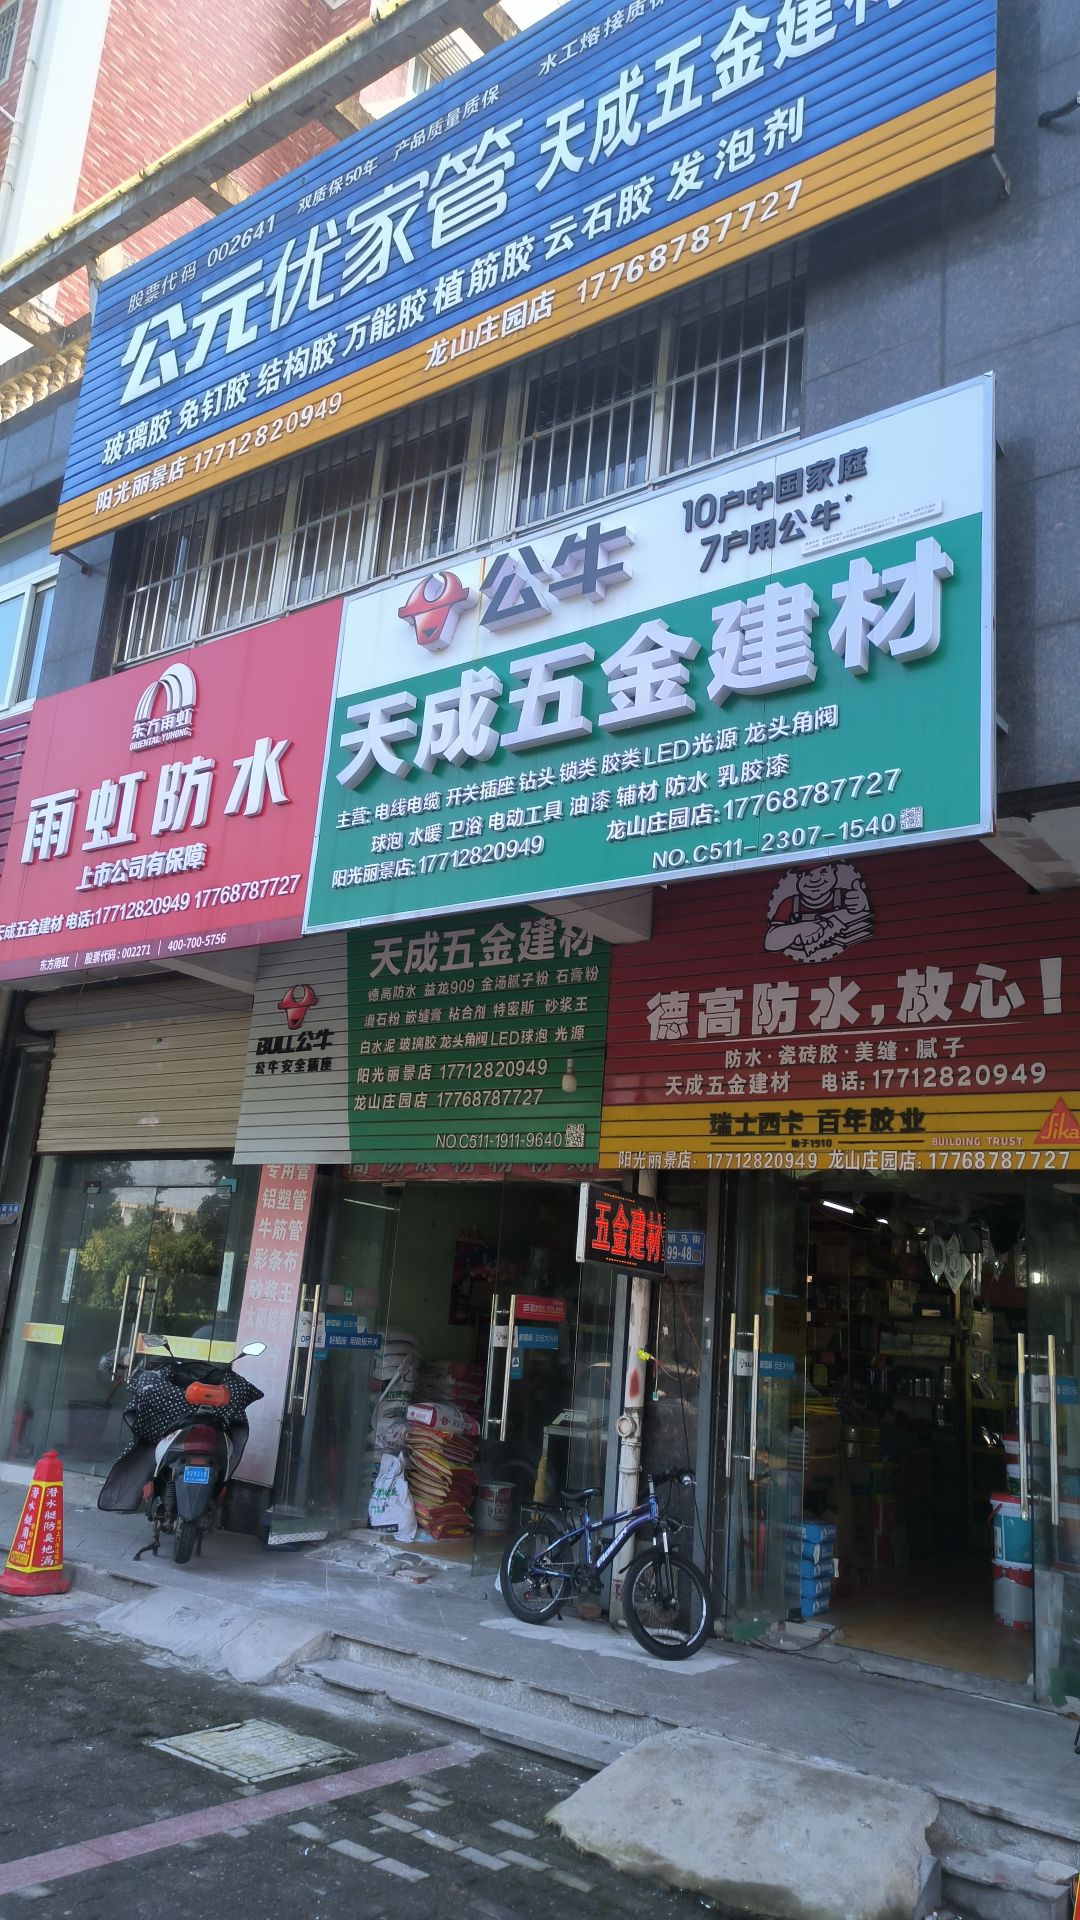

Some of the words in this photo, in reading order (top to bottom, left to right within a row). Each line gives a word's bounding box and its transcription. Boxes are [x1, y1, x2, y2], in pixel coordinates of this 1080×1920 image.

[127, 260, 197, 314] 股票代码
[207, 213, 276, 268] 002641
[297, 156, 378, 214] 双质保50年
[393, 85, 500, 162] 产品质量质保
[119, 117, 524, 406] 公元优家管
[101, 409, 174, 466] 玻璃胶
[175, 372, 251, 435] 免钉胶
[255, 330, 338, 398] 结构胶
[340, 288, 428, 357] 万能胶
[432, 236, 534, 315] 植筋胶
[541, 175, 655, 261] 云石胶
[665, 97, 804, 202] 发泡剂
[94, 455, 186, 515] 阳光丽景店
[191, 391, 343, 474] 17712820949
[424, 288, 556, 372] 龙山庄园店
[575, 179, 803, 304] 17768787727
[682, 446, 868, 533] 10户中国家庭
[478, 520, 636, 634] 公牛
[334, 534, 956, 791] 天成五金建材
[129, 735, 162, 751] ORIENTAL
[162, 726, 193, 742] YUHONG
[132, 708, 195, 740] 东方雨虹
[374, 791, 442, 822] 电线电缆
[445, 774, 516, 808] 开关插座
[518, 766, 556, 793] 钻头
[559, 757, 599, 784] 锁类
[743, 703, 840, 746] 龙头角阀
[20, 736, 294, 865] 雨虹防水
[370, 831, 405, 854] 球泡
[408, 823, 444, 848] 水暖
[447, 816, 484, 841] 卫浴
[488, 800, 564, 831] 电动工具
[569, 788, 611, 818] 油漆
[616, 778, 659, 808] 辅材
[665, 771, 710, 797] 防水
[718, 753, 791, 788] 乳胶漆
[75, 842, 208, 892] 上市公司有保障
[194, 873, 302, 910] 17768787727
[40, 956, 70, 971] 东方雨虹
[167, 932, 227, 952] 400-700-5756
[369, 917, 598, 978] 天成五金建材
[367, 984, 417, 1003] 德高防水
[423, 979, 475, 998] 益龙909
[480, 970, 549, 992] 金汤腻子粉
[555, 965, 600, 984] 石膏粉
[364, 1011, 401, 1029] 滑石粉
[405, 1007, 442, 1025] 嵌缝膏
[448, 1004, 487, 1022] 粘合剂
[492, 999, 535, 1018] 特密斯
[544, 995, 589, 1013] 砂浆王
[359, 1038, 396, 1055] 白水泥
[398, 1034, 437, 1052] 玻璃胶
[440, 1031, 488, 1049] 龙头角阀
[490, 1027, 548, 1047] LED球泡
[554, 1024, 586, 1042] 光源
[356, 1063, 432, 1084] 阳光丽景店
[439, 1058, 548, 1081] 17712820949
[664, 1071, 792, 1097] 天成五金建材
[353, 1091, 429, 1112] 龙山庄园店
[437, 1088, 544, 1108] 17768787727
[709, 1109, 804, 1136] 瑞士西卡
[816, 1106, 926, 1134] 百年胶业
[1040, 1111, 1080, 1141] Sika
[931, 1136, 981, 1147] BUILDING
[986, 1135, 1024, 1146] TRUST
[706, 1152, 818, 1169] 17712820949
[262, 1187, 308, 1212] 铝塑管
[257, 1217, 304, 1242] 牛筋管
[592, 1200, 663, 1264] 五金建材
[253, 1247, 299, 1273] 彩条布
[248, 1280, 293, 1304] 砂浆王
